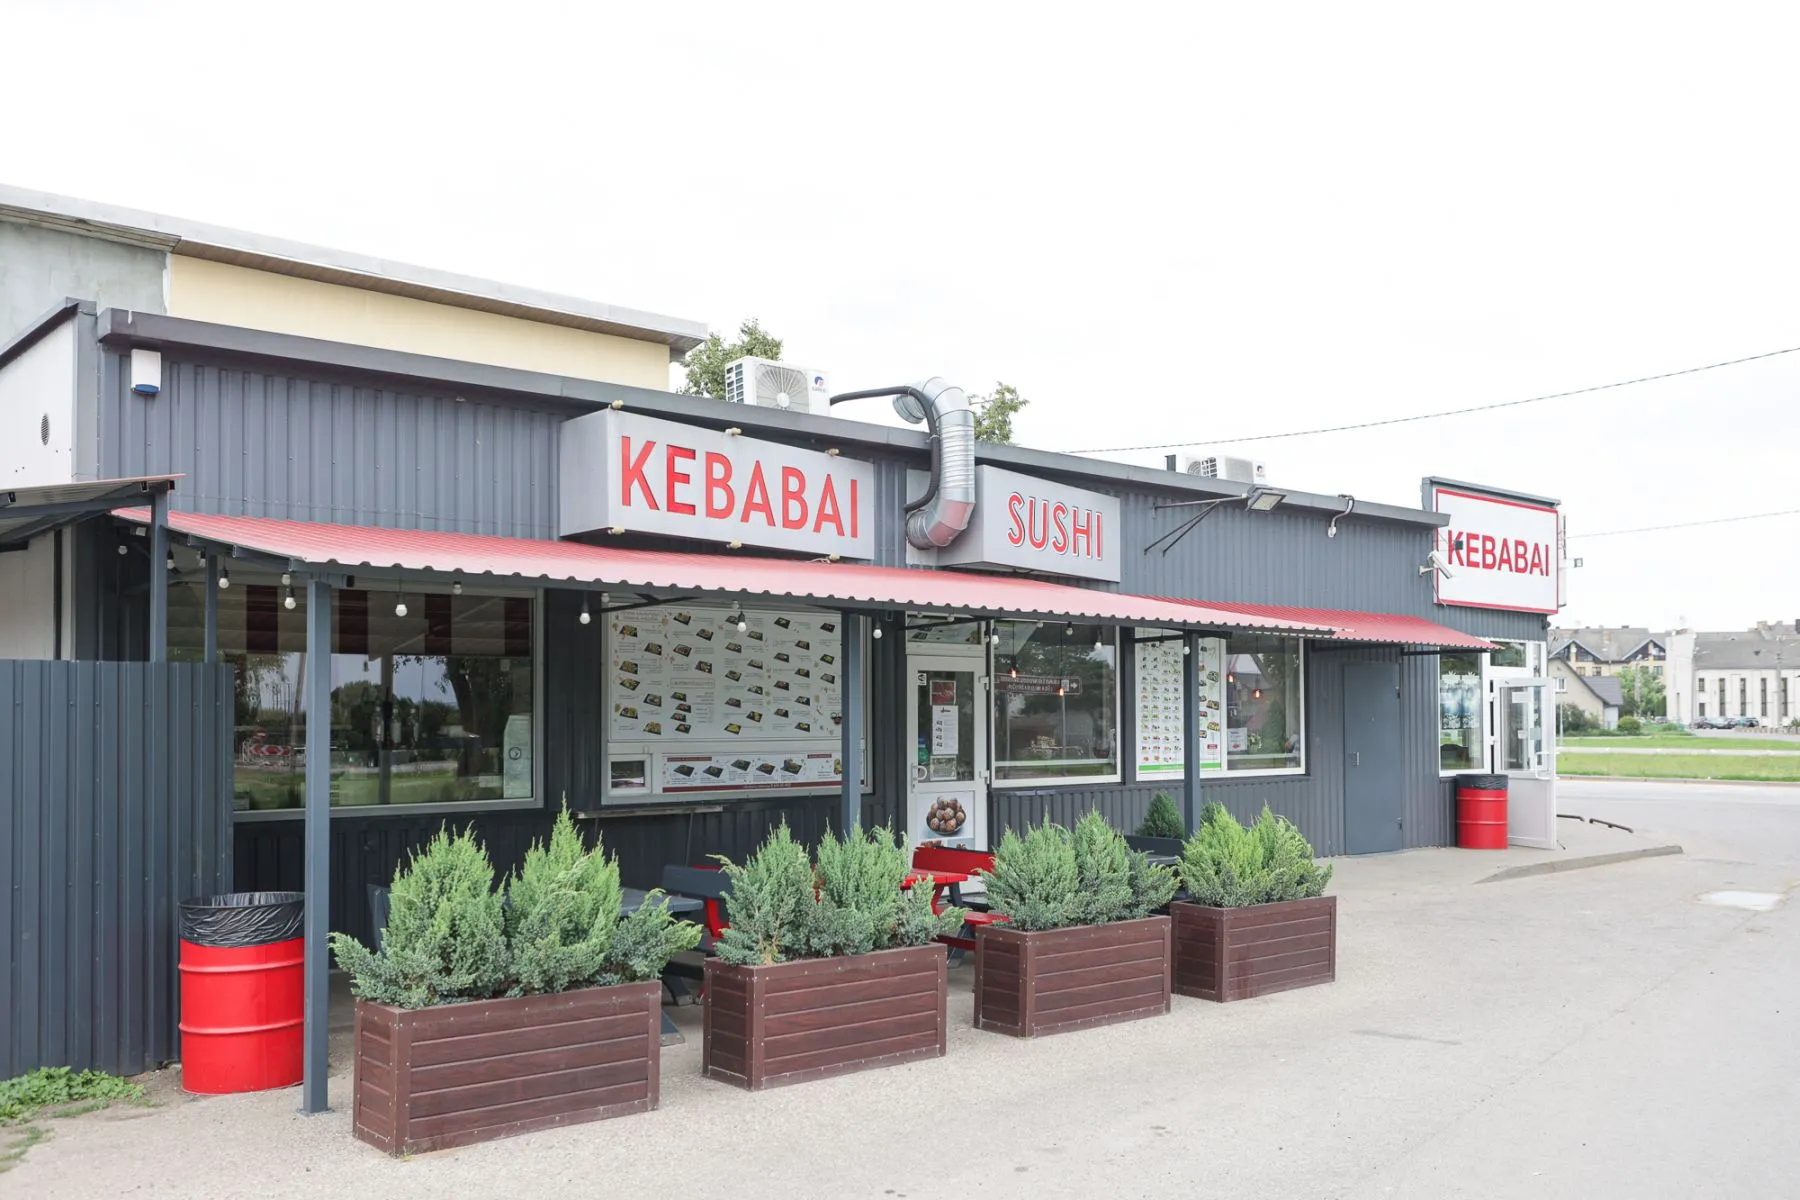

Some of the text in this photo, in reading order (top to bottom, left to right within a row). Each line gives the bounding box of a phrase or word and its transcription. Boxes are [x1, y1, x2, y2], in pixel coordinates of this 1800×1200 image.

[621, 435, 858, 538] KEBABAI
[1008, 491, 1103, 561] SUSHI
[1447, 530, 1549, 577] KEBABAI
